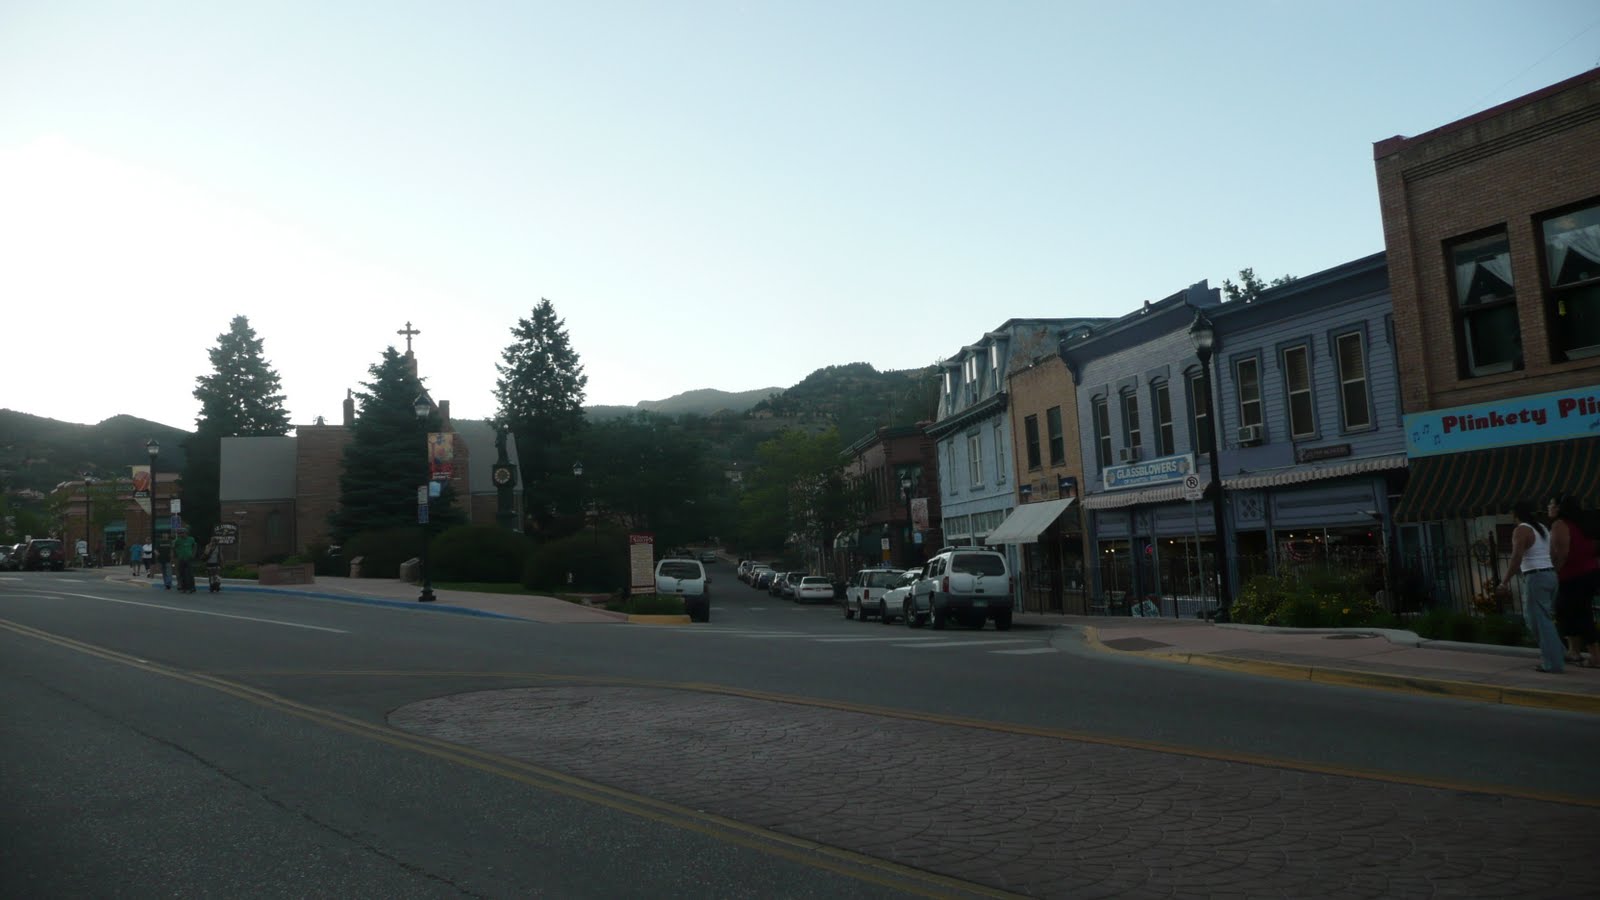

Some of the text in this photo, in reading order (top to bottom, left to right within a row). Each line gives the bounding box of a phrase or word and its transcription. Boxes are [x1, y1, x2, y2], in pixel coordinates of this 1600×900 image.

[1442, 396, 1600, 434] Plinkety Pli
[1116, 460, 1177, 479] GLASSBLOWERS
